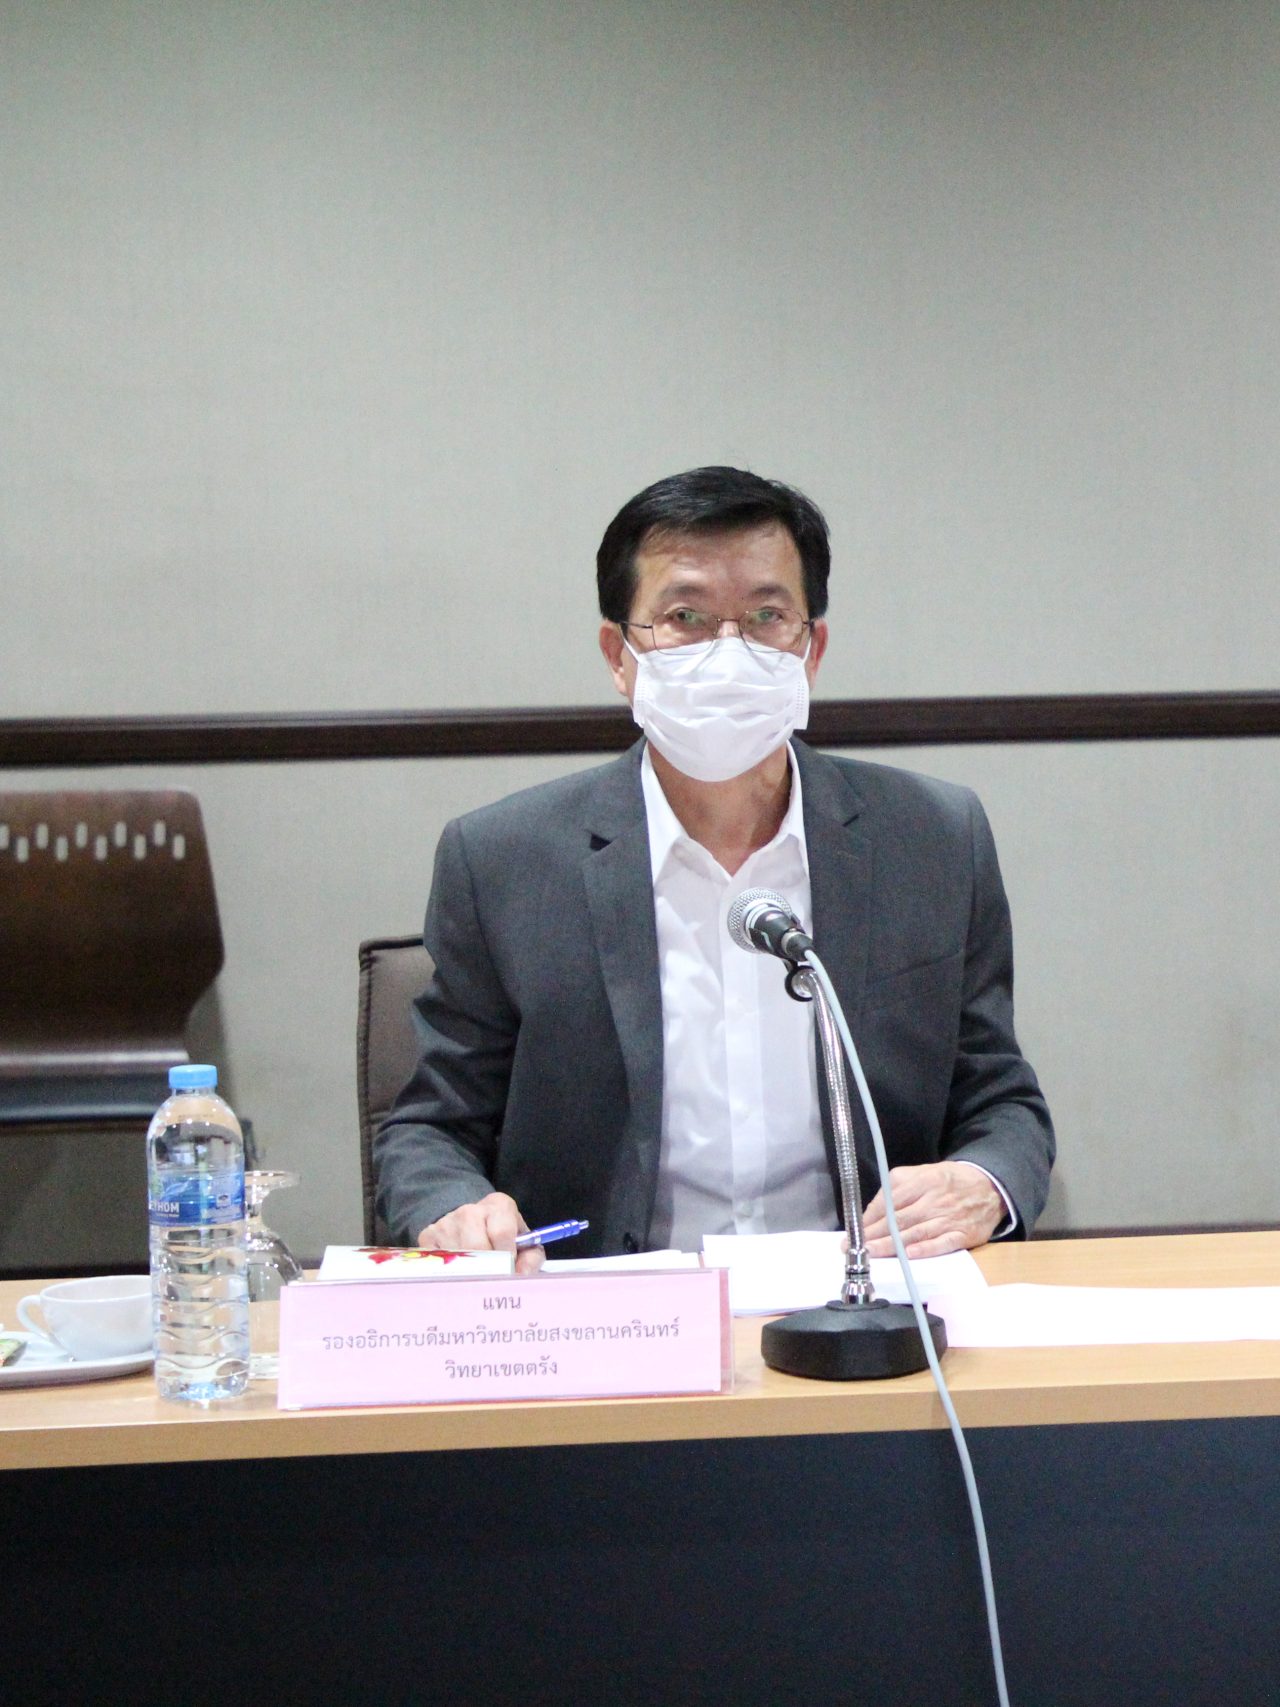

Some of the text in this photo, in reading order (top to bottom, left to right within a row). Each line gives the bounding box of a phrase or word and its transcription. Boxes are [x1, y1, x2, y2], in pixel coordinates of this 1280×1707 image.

[482, 1293, 522, 1311] แทน
[322, 1317, 680, 1350] รองอธิการบดีมหาวิทยาลัยสงขลานครินทร์
[445, 1356, 559, 1379] วิทยาเขตตรัง
